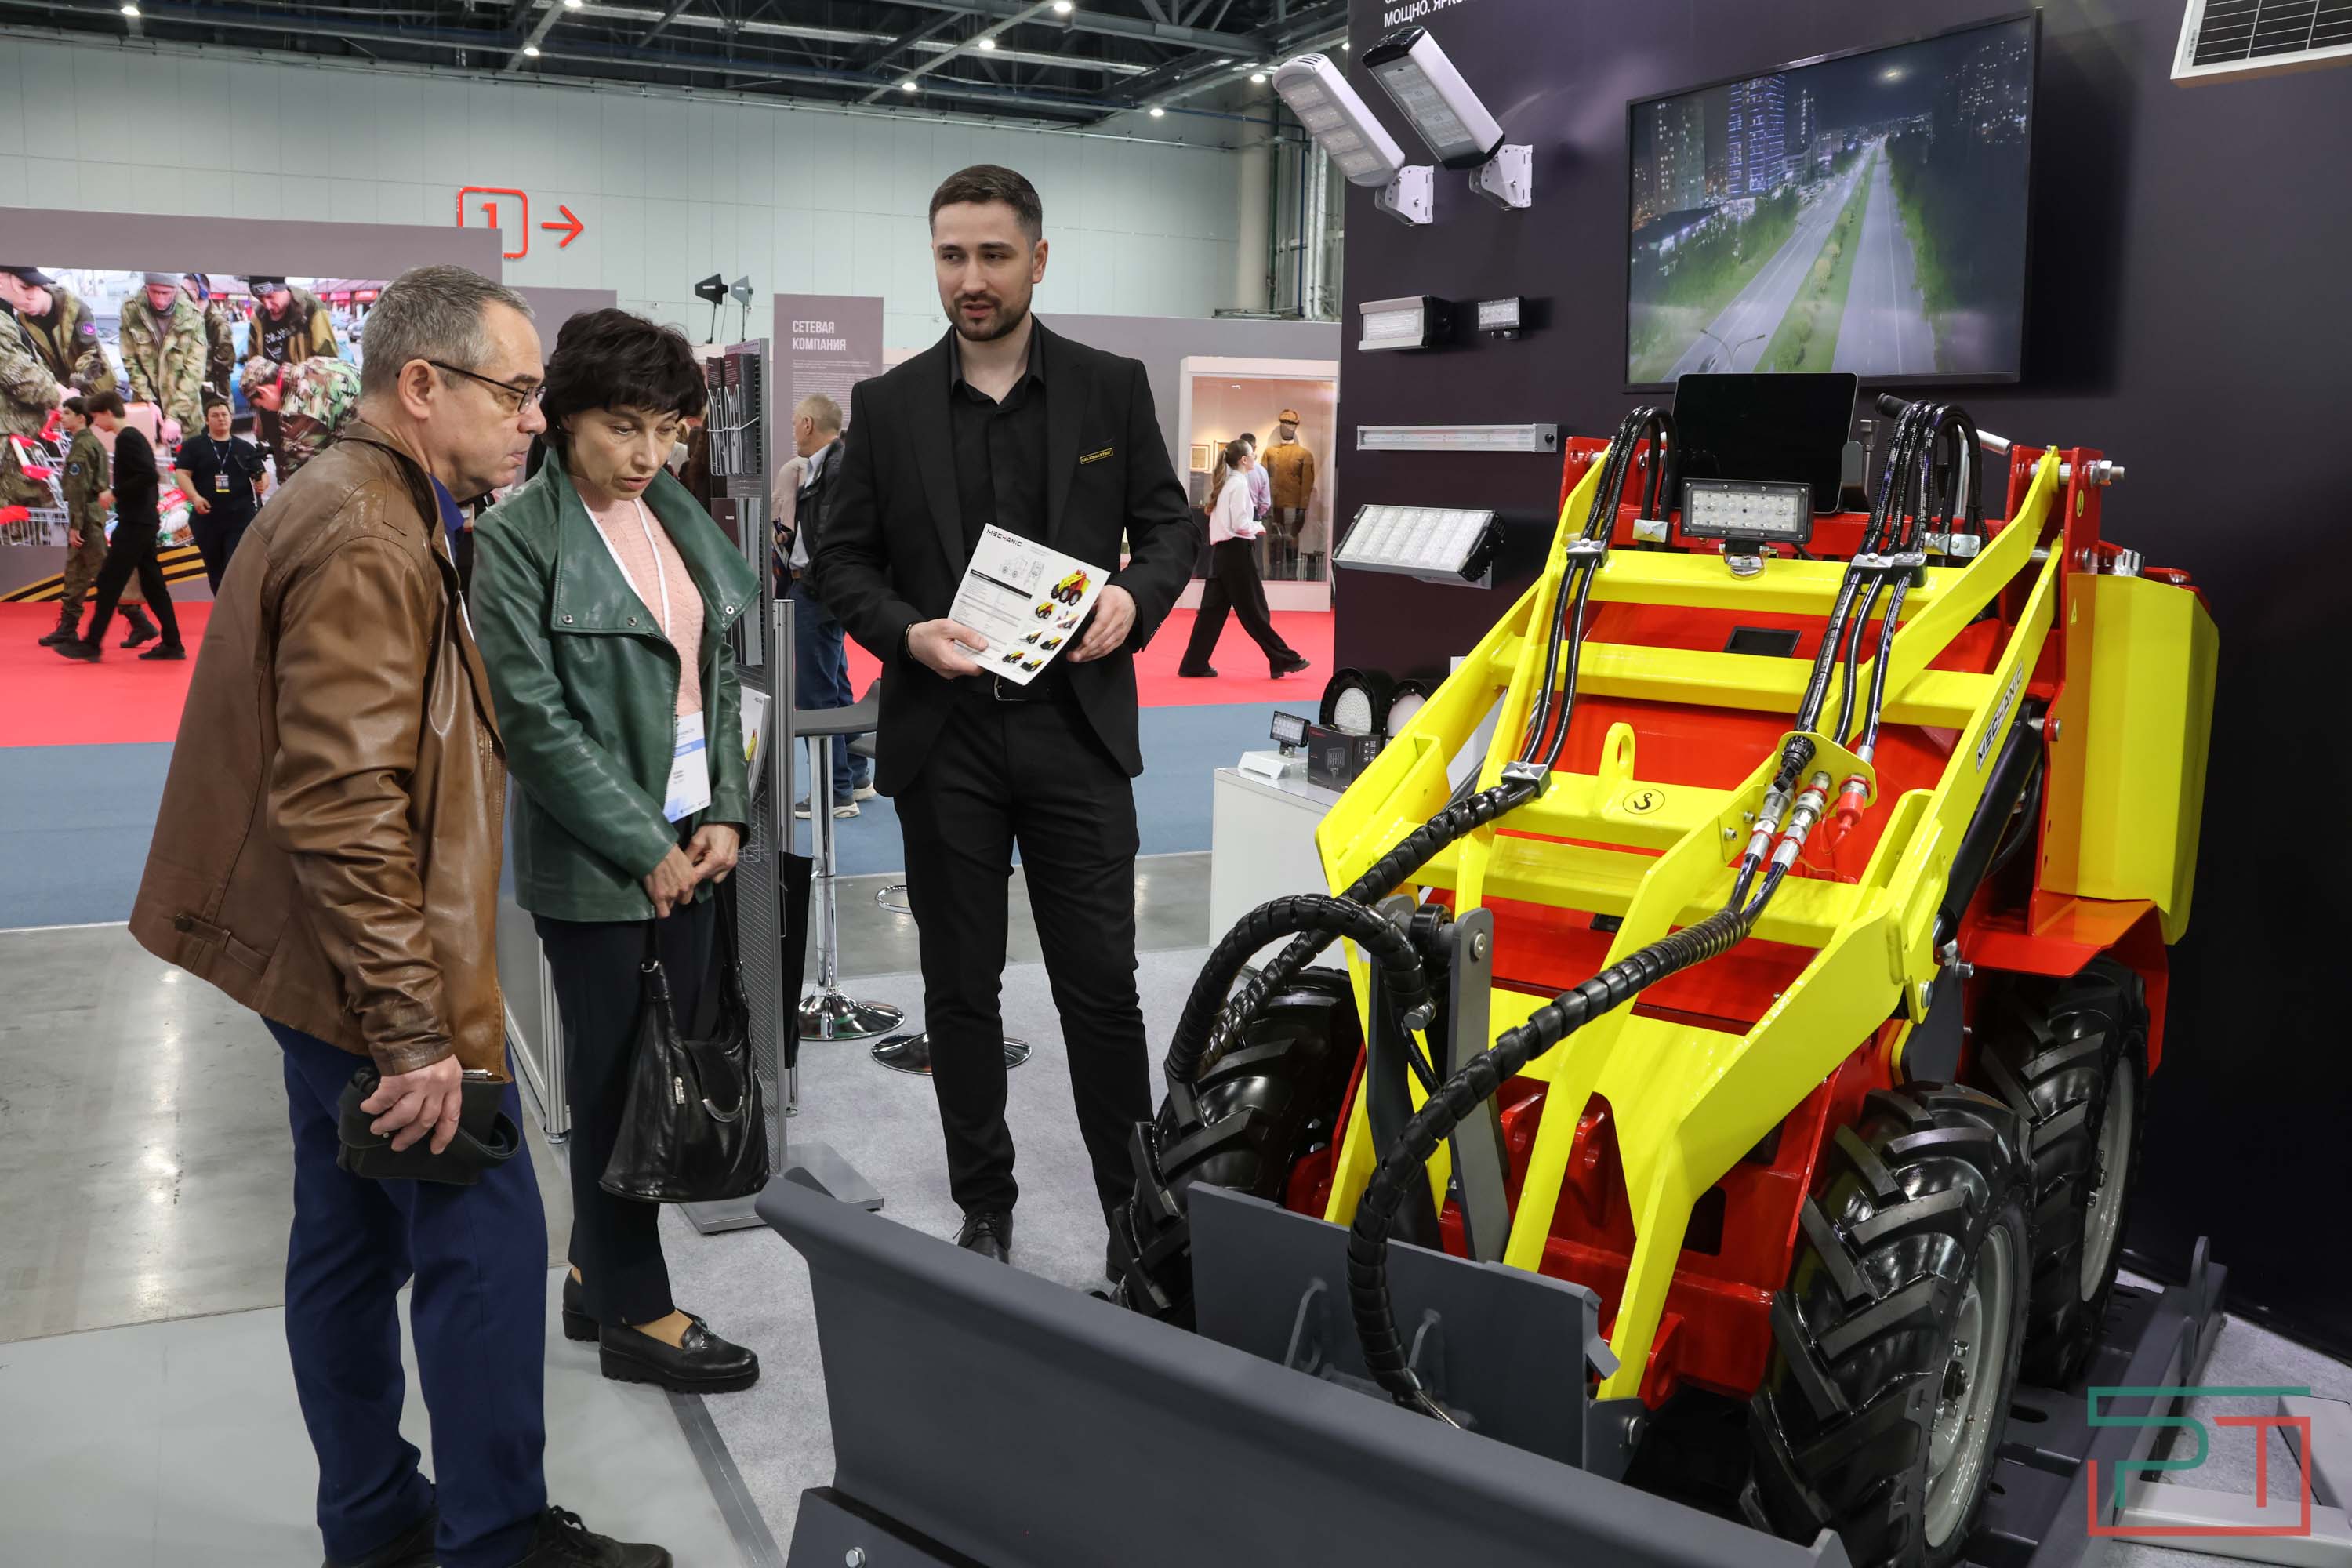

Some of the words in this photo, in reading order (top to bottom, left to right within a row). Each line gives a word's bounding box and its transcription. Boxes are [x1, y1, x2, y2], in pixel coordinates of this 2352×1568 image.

[1384, 0, 1431, 27] МОЩНО.
[1432, 0, 1463, 11] ЯР
[792, 320, 835, 334] СЕТЕВАЯ
[792, 337, 847, 351] КОМПАНИЯ
